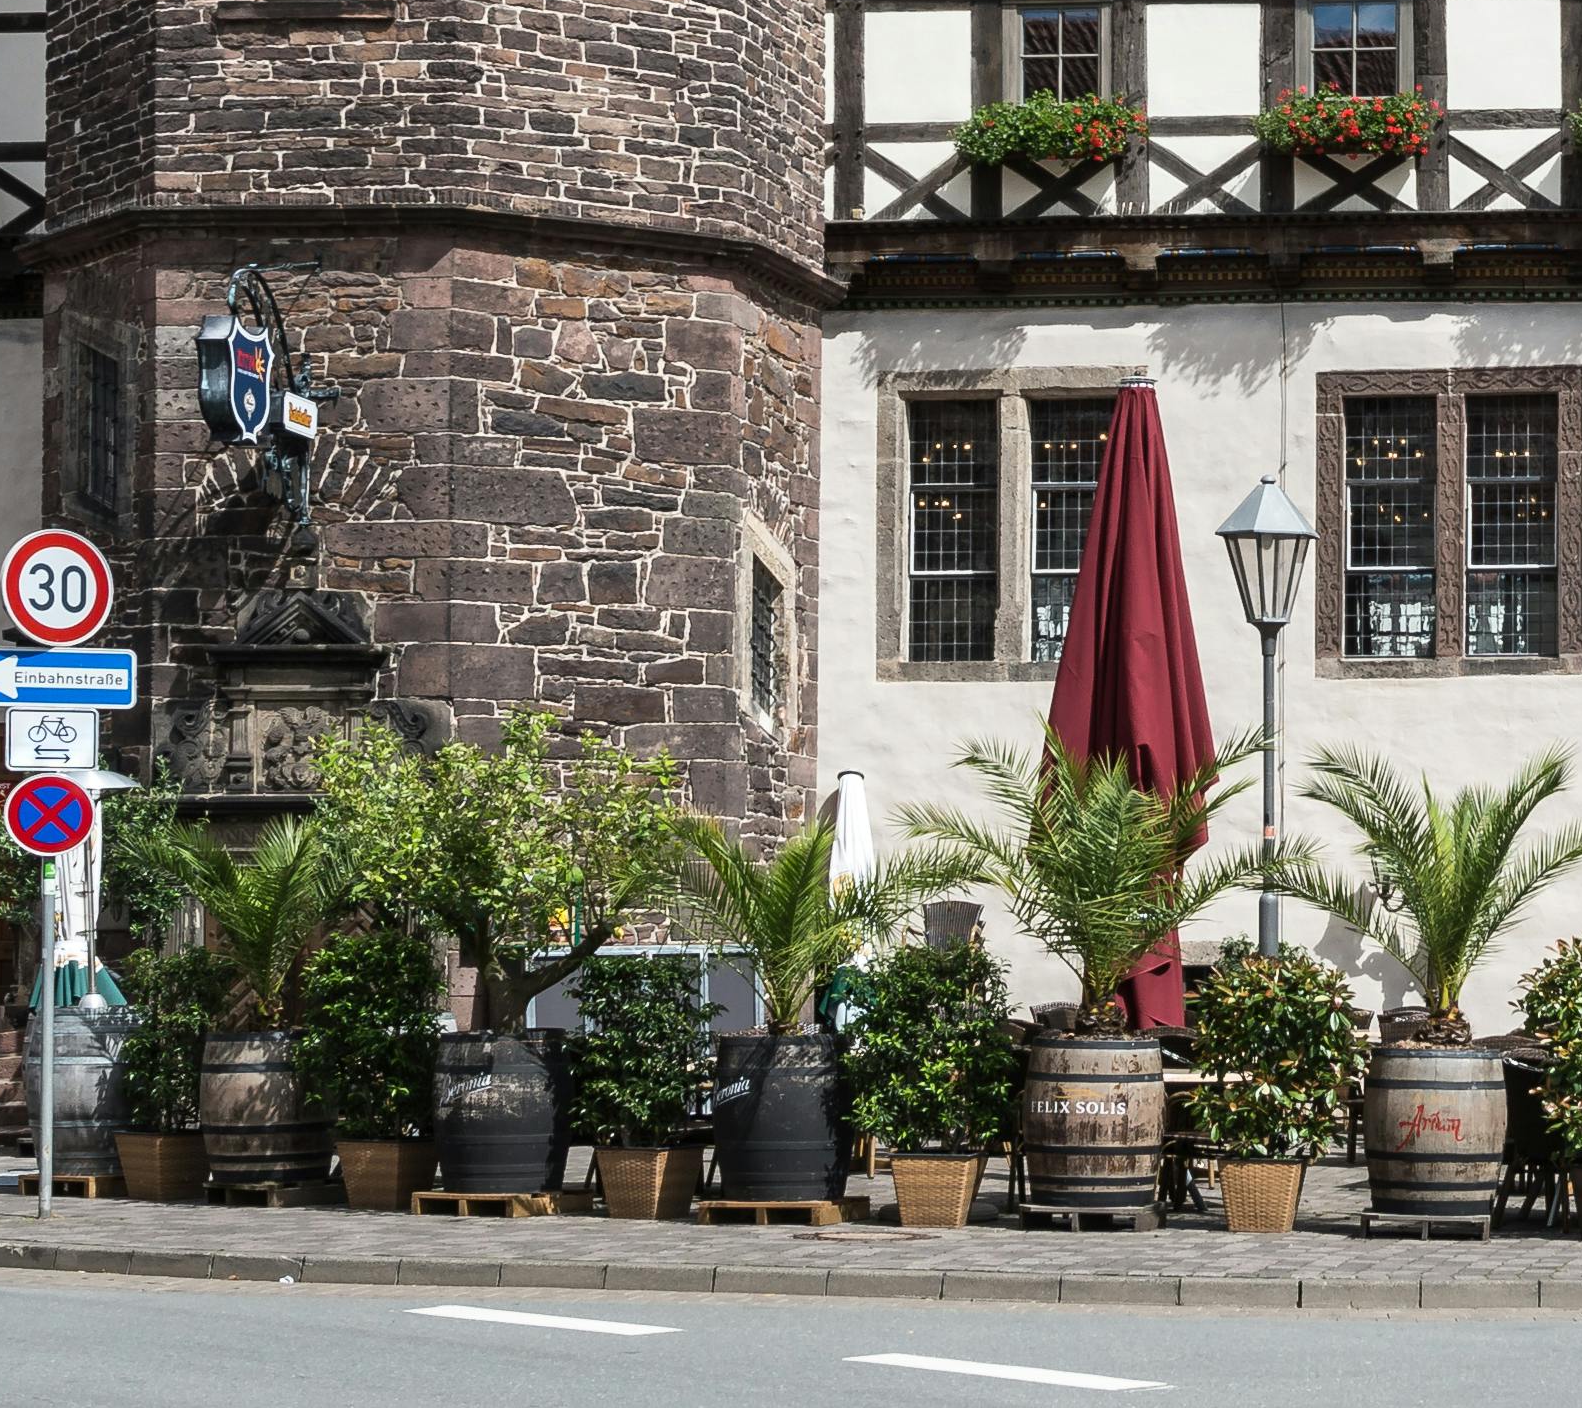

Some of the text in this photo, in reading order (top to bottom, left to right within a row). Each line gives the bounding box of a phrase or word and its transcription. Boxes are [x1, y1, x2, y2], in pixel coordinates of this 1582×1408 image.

[29, 563, 87, 614] 30
[14, 671, 123, 686] Einbahnstraße
[1030, 1100, 1127, 1115] FELIX SOLIS
